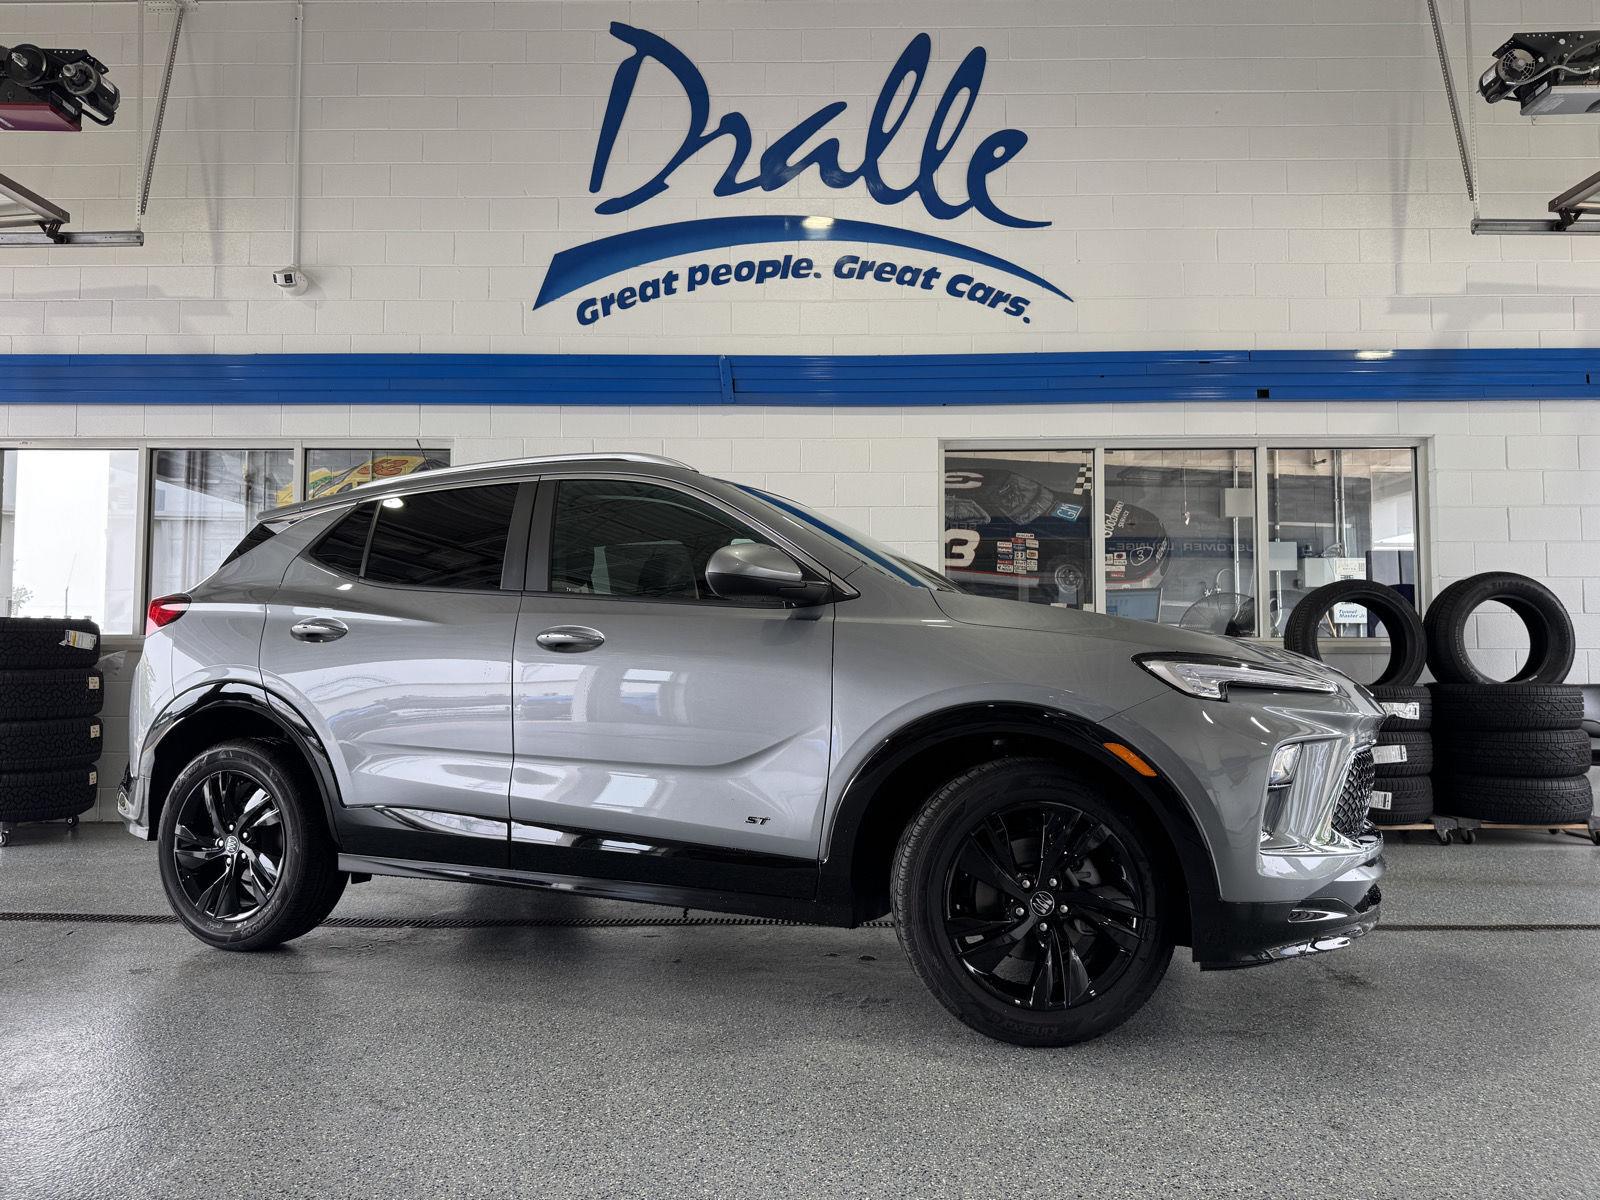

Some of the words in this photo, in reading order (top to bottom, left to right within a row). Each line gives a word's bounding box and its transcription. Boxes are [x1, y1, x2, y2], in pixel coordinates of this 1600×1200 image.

[589, 21, 1053, 229] Dralle
[576, 270, 679, 326] Great
[687, 254, 822, 292] people.
[833, 254, 942, 290] Great
[946, 273, 1031, 324] Cars.
[945, 528, 981, 567] 3
[1136, 549, 1145, 561] 3
[744, 816, 771, 825] ST
